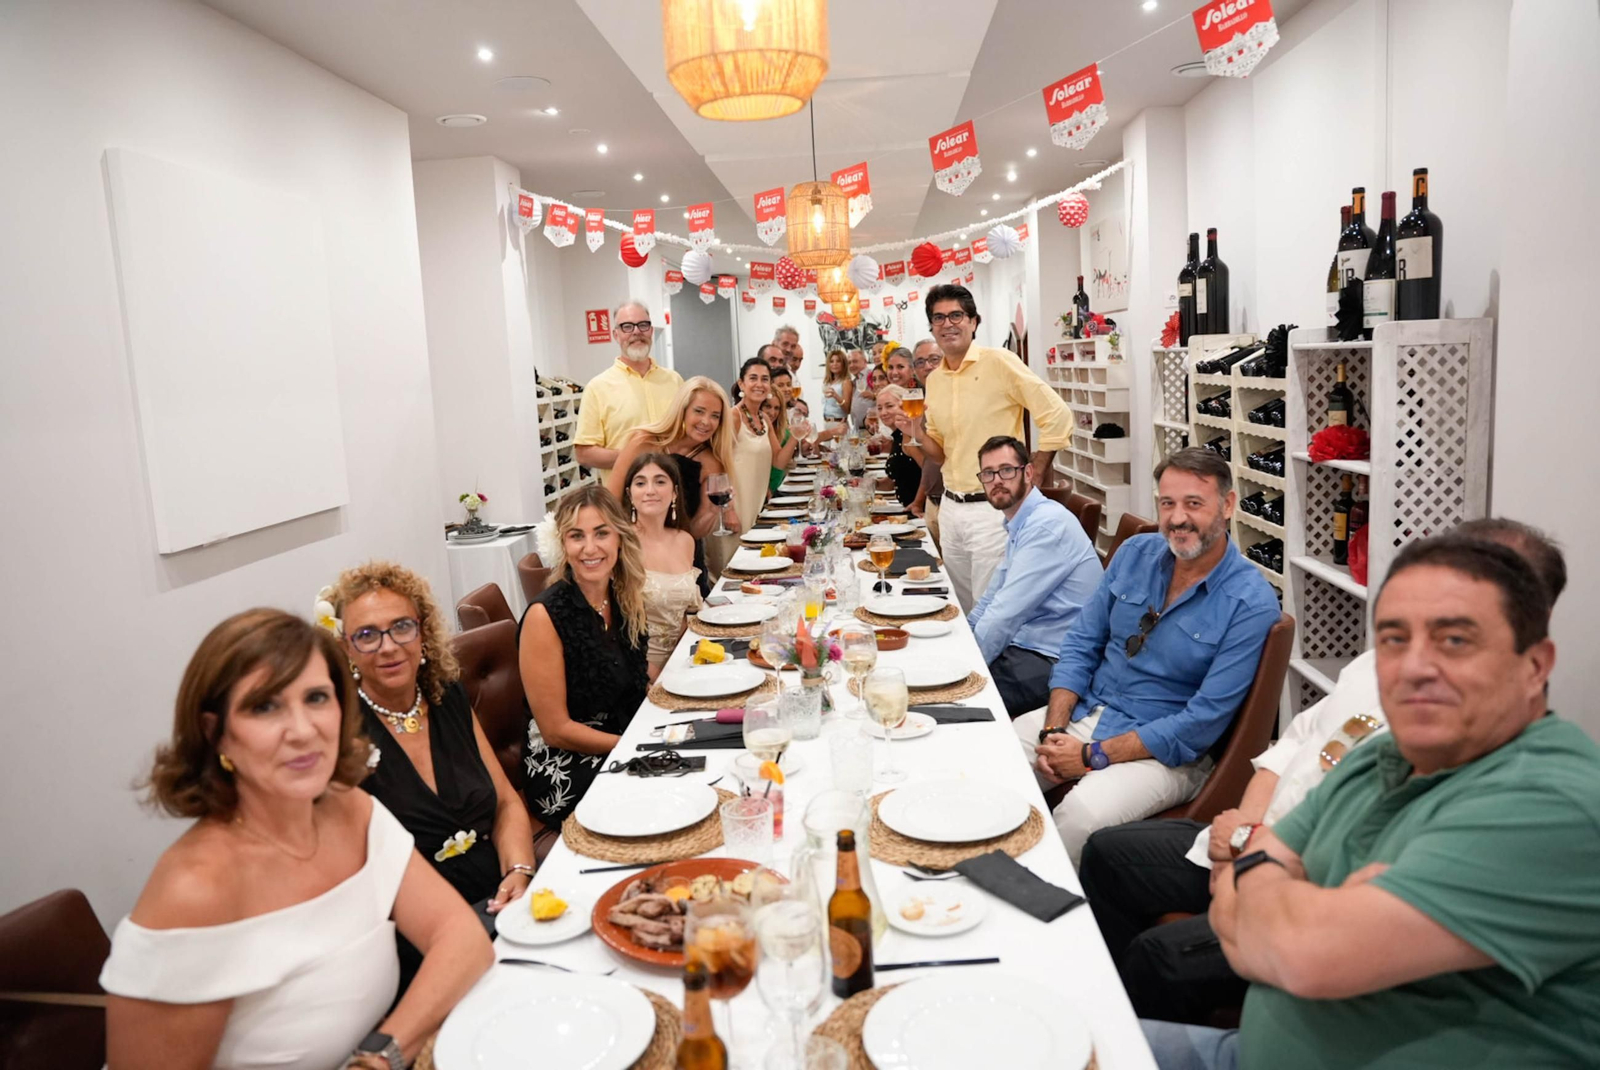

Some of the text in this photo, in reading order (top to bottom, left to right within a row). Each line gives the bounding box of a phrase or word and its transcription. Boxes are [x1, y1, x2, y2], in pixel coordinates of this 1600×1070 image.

[1049, 76, 1093, 106] Solear
[933, 131, 969, 155] Solear
[757, 194, 781, 209] Solear
